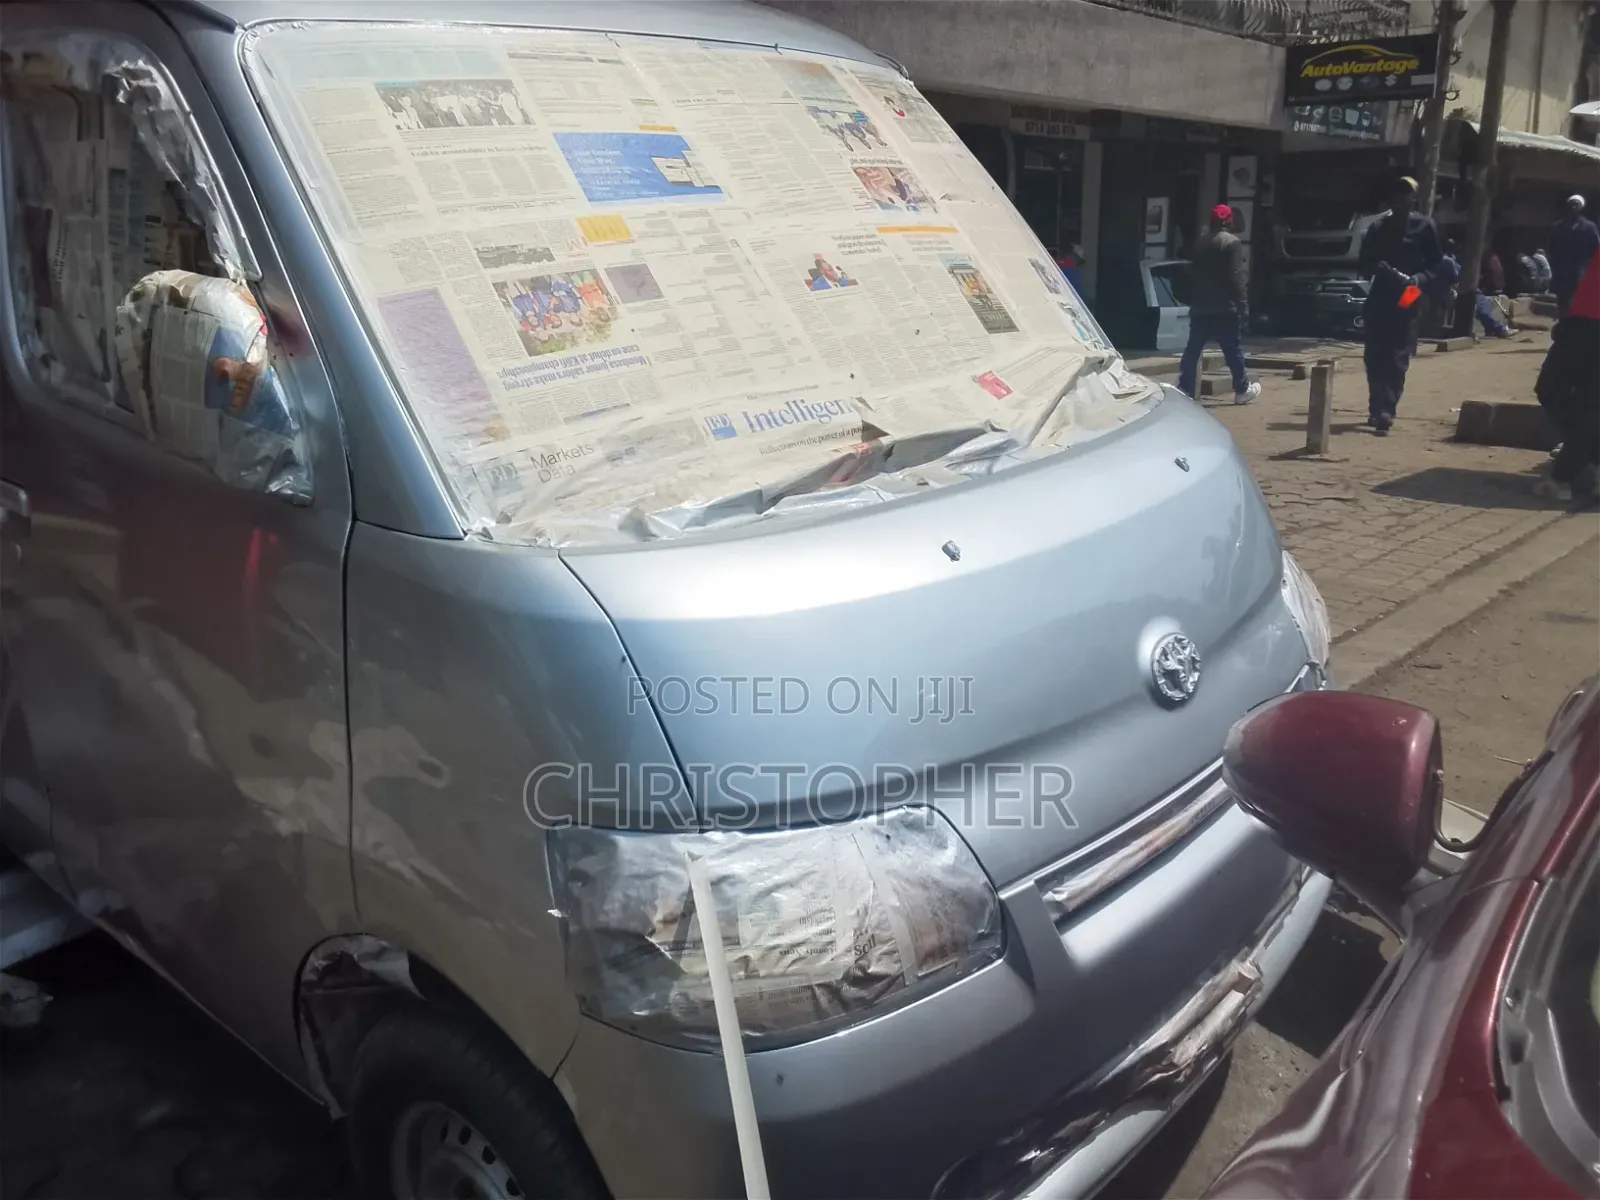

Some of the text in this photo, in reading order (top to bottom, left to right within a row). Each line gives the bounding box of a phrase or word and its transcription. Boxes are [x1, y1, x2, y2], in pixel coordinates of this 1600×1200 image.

[1300, 59, 1420, 78] AutoVantage
[532, 372, 557, 385] make
[530, 443, 596, 470] Markets
[537, 463, 577, 484] Data
